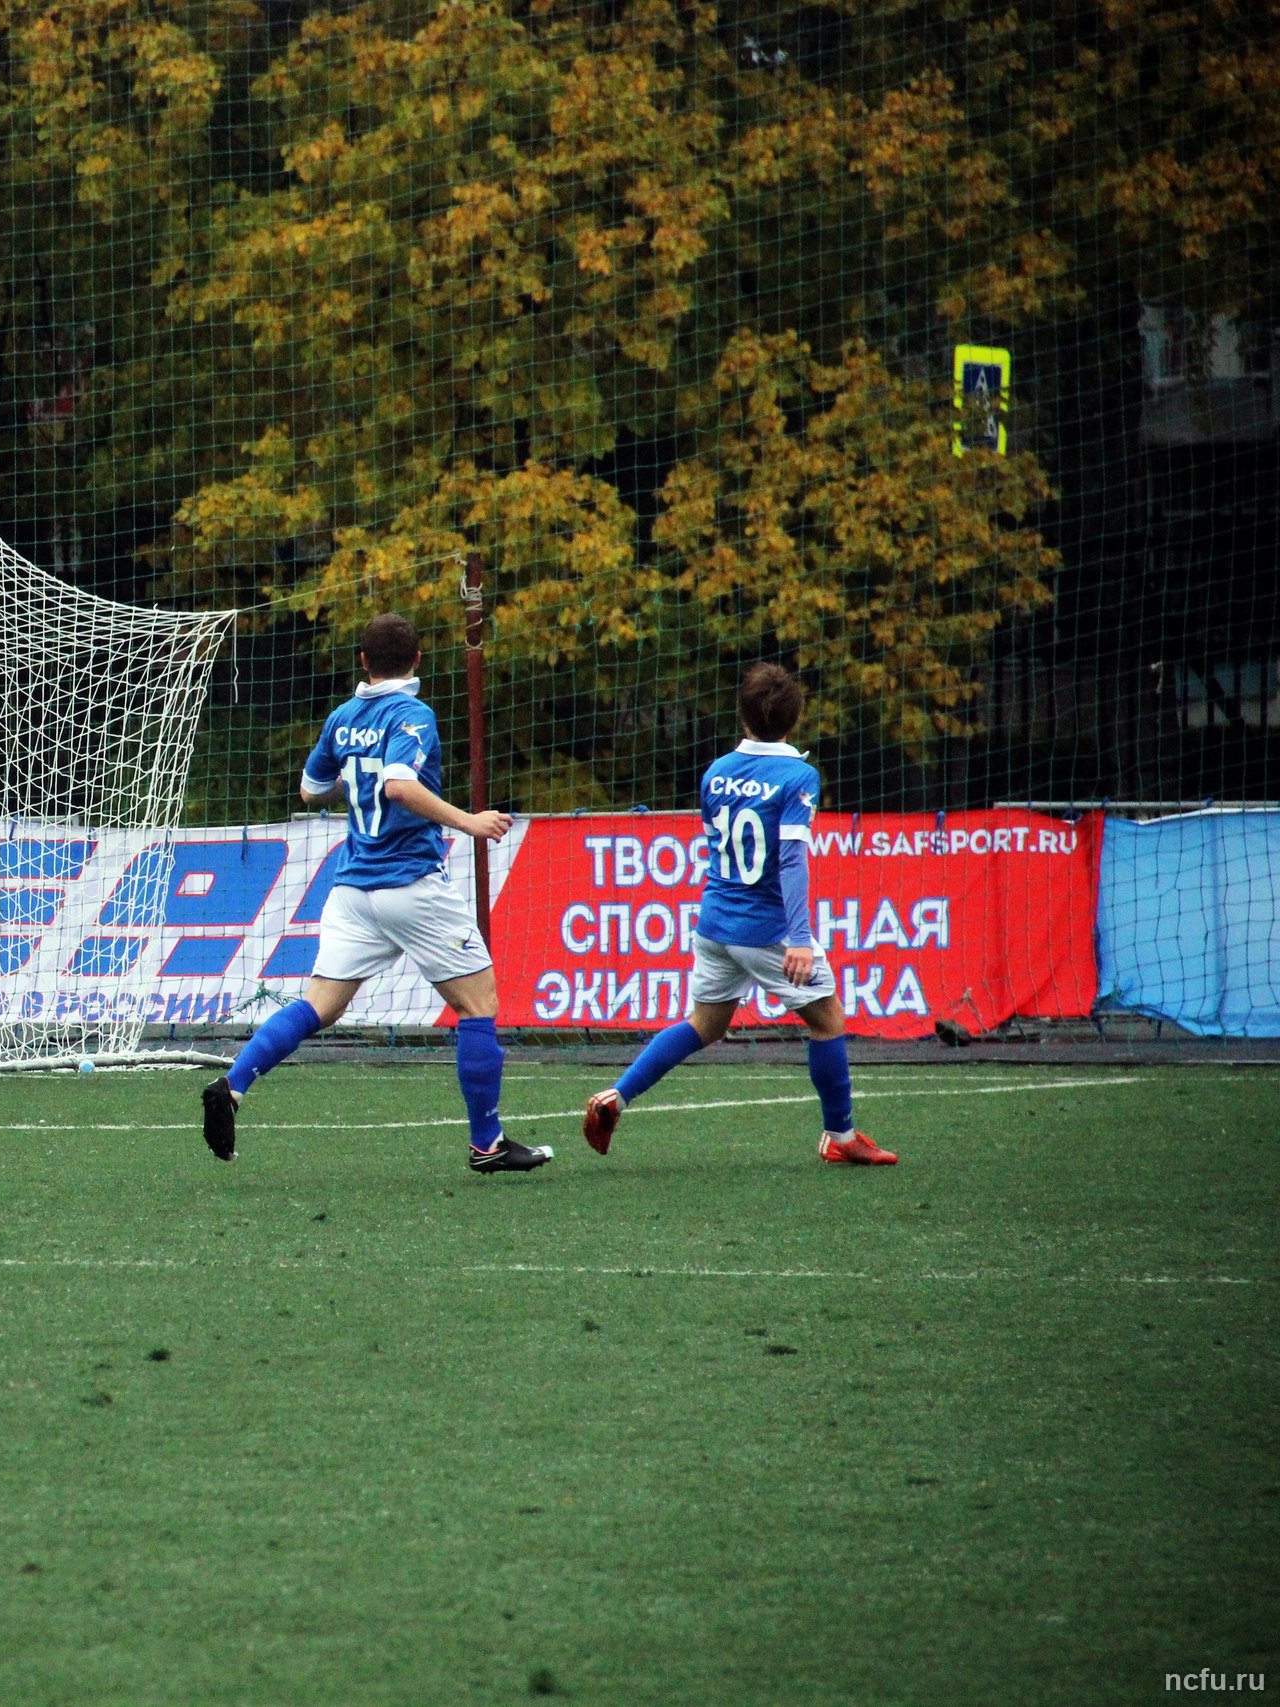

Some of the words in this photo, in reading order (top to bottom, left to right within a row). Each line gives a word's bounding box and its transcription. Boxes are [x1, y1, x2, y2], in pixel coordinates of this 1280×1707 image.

[340, 755, 384, 837] 17
[710, 776, 780, 800] СКФУ
[712, 805, 766, 885] 10
[808, 826, 1078, 857] WW.SAFSPORT.RU
[561, 897, 950, 955] СПОРНАЯ
[19, 991, 45, 1020] В
[533, 964, 931, 1021] ЭКИПКА
